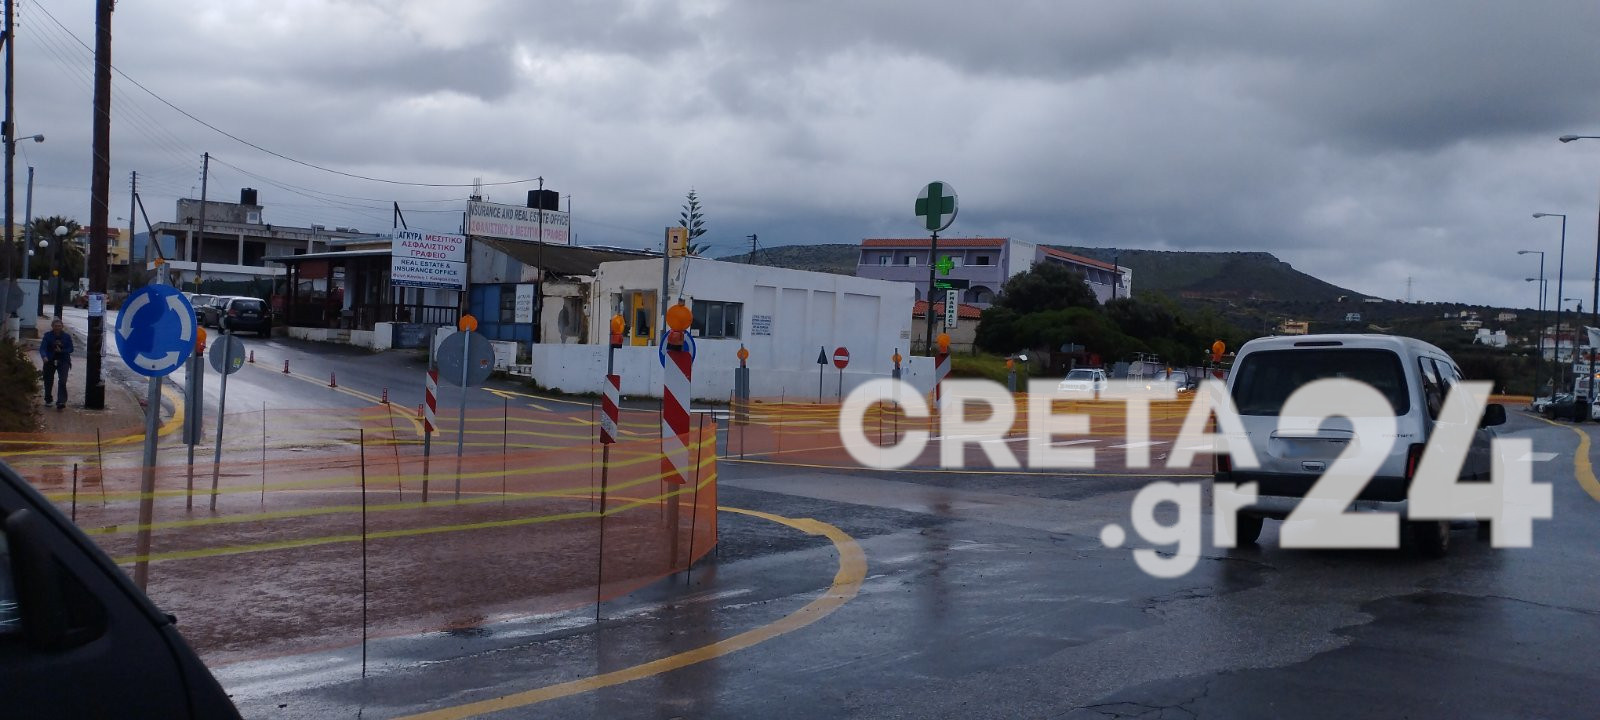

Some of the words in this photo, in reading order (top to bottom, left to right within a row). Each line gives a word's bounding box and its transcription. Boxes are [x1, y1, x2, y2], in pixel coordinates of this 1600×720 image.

[502, 207, 514, 219] AND
[515, 208, 528, 222] REAL
[529, 211, 550, 225] ESTTE
[551, 213, 569, 227] OFFICE
[471, 220, 508, 236] ΣΦΑΛΙΣΤΙΚΟ
[516, 225, 542, 240] ΜΕΣΙΤΙΚ
[398, 231, 423, 241] ΑΓΚΥΡΑ
[425, 234, 463, 244] ΜΕΣΙΤΙΚΟ
[401, 240, 456, 252] ΑΣΦΑΛΙΣΤΙΚΟ
[410, 249, 447, 259] ΓΡΑΦΕΙΟ
[394, 265, 434, 274] INSURANCE
